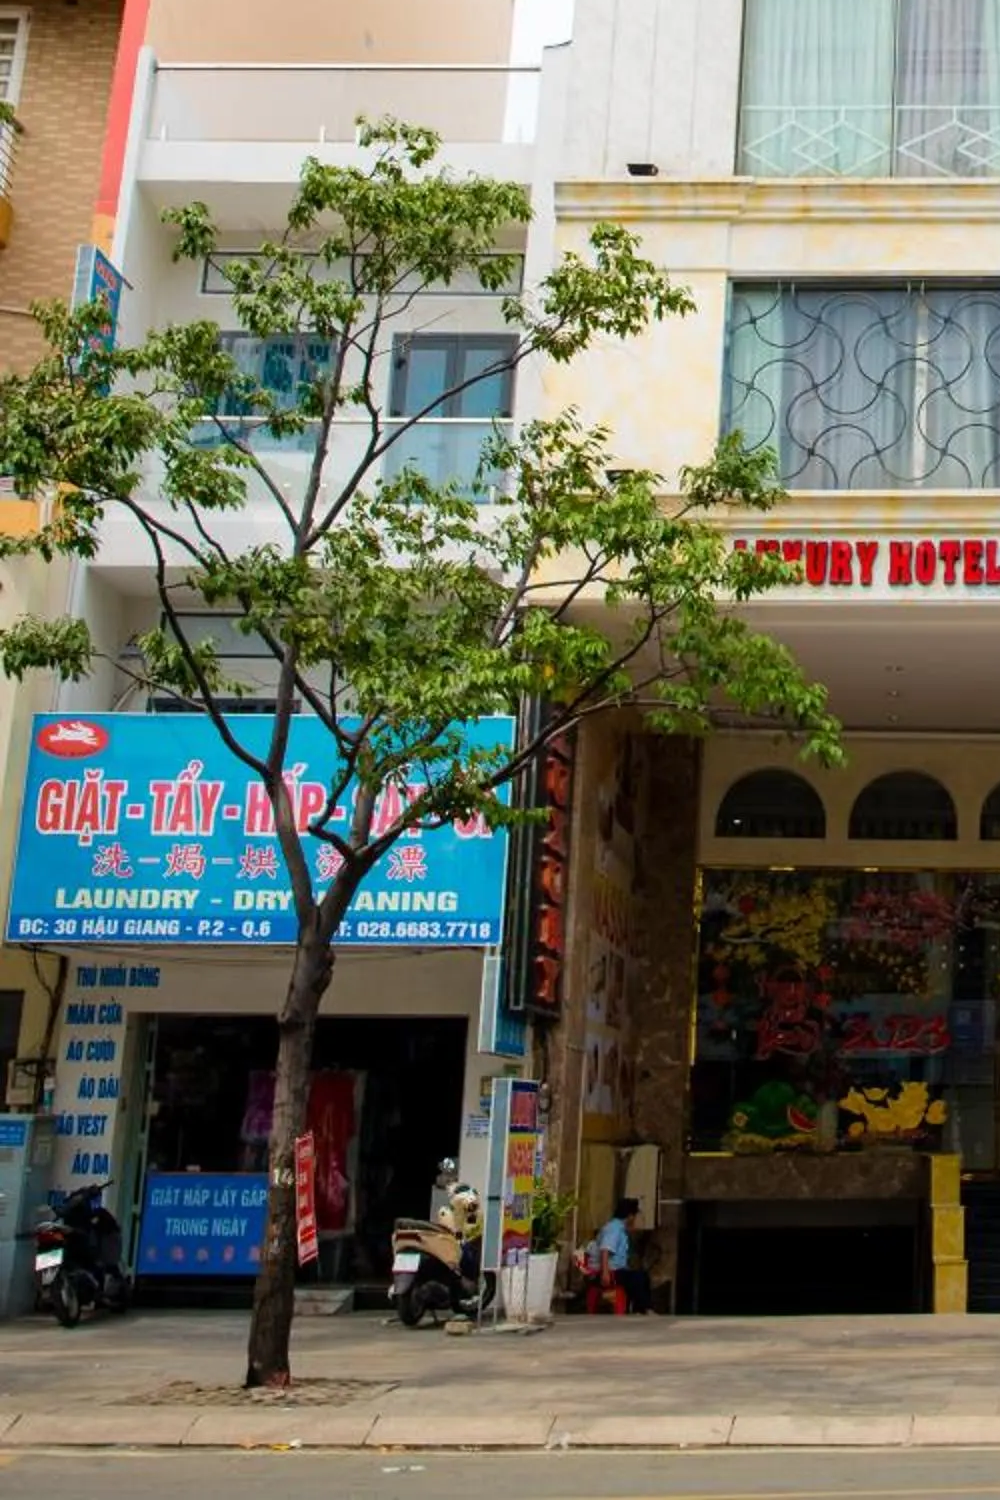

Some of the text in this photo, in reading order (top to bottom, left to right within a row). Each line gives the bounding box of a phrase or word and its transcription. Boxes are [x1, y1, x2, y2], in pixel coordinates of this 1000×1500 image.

[733, 539, 879, 587] XURY
[36, 768, 128, 847] GIẶT
[149, 759, 224, 838] TẨY
[244, 763, 329, 838] HP
[55, 887, 200, 911] LAUNDRY
[233, 888, 293, 912] DRY
[54, 918, 77, 935] 30
[123, 918, 181, 936] GIANG
[77, 1115, 108, 1136] VEST
[165, 1217, 209, 1238] TRONG
